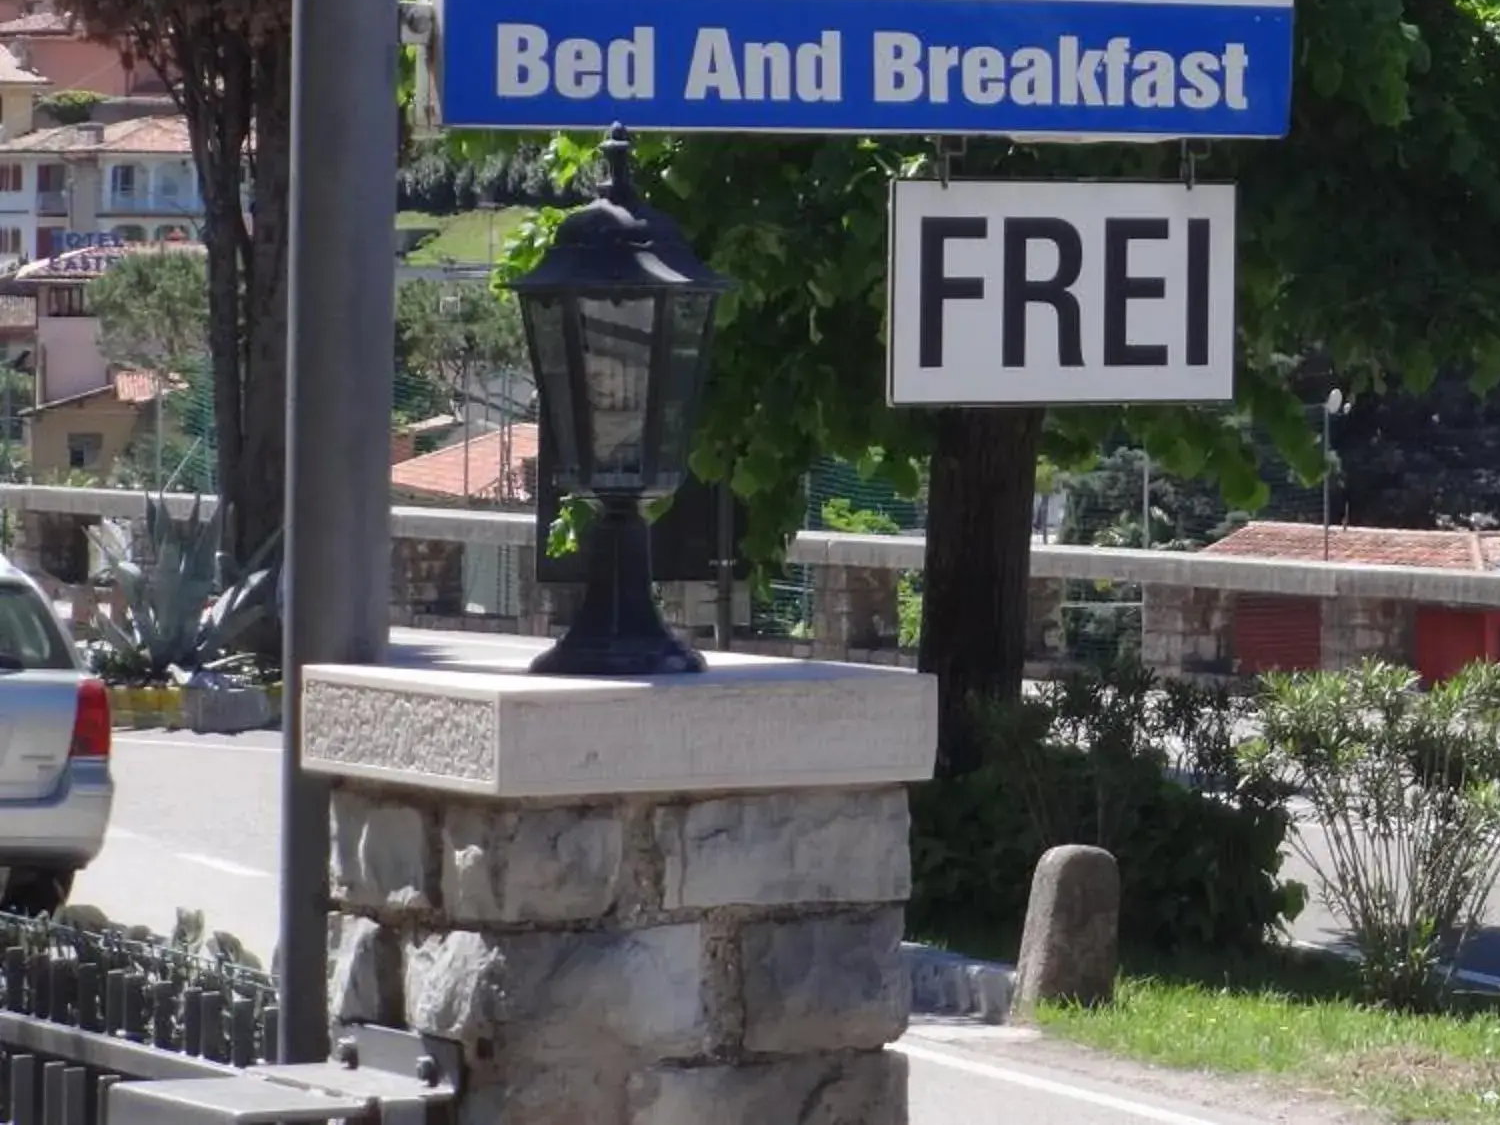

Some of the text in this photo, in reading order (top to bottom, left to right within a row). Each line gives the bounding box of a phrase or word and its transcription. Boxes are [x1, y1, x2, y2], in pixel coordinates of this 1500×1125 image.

[497, 23, 1249, 110] Bed And Breakfast
[919, 216, 1211, 368] FREI
